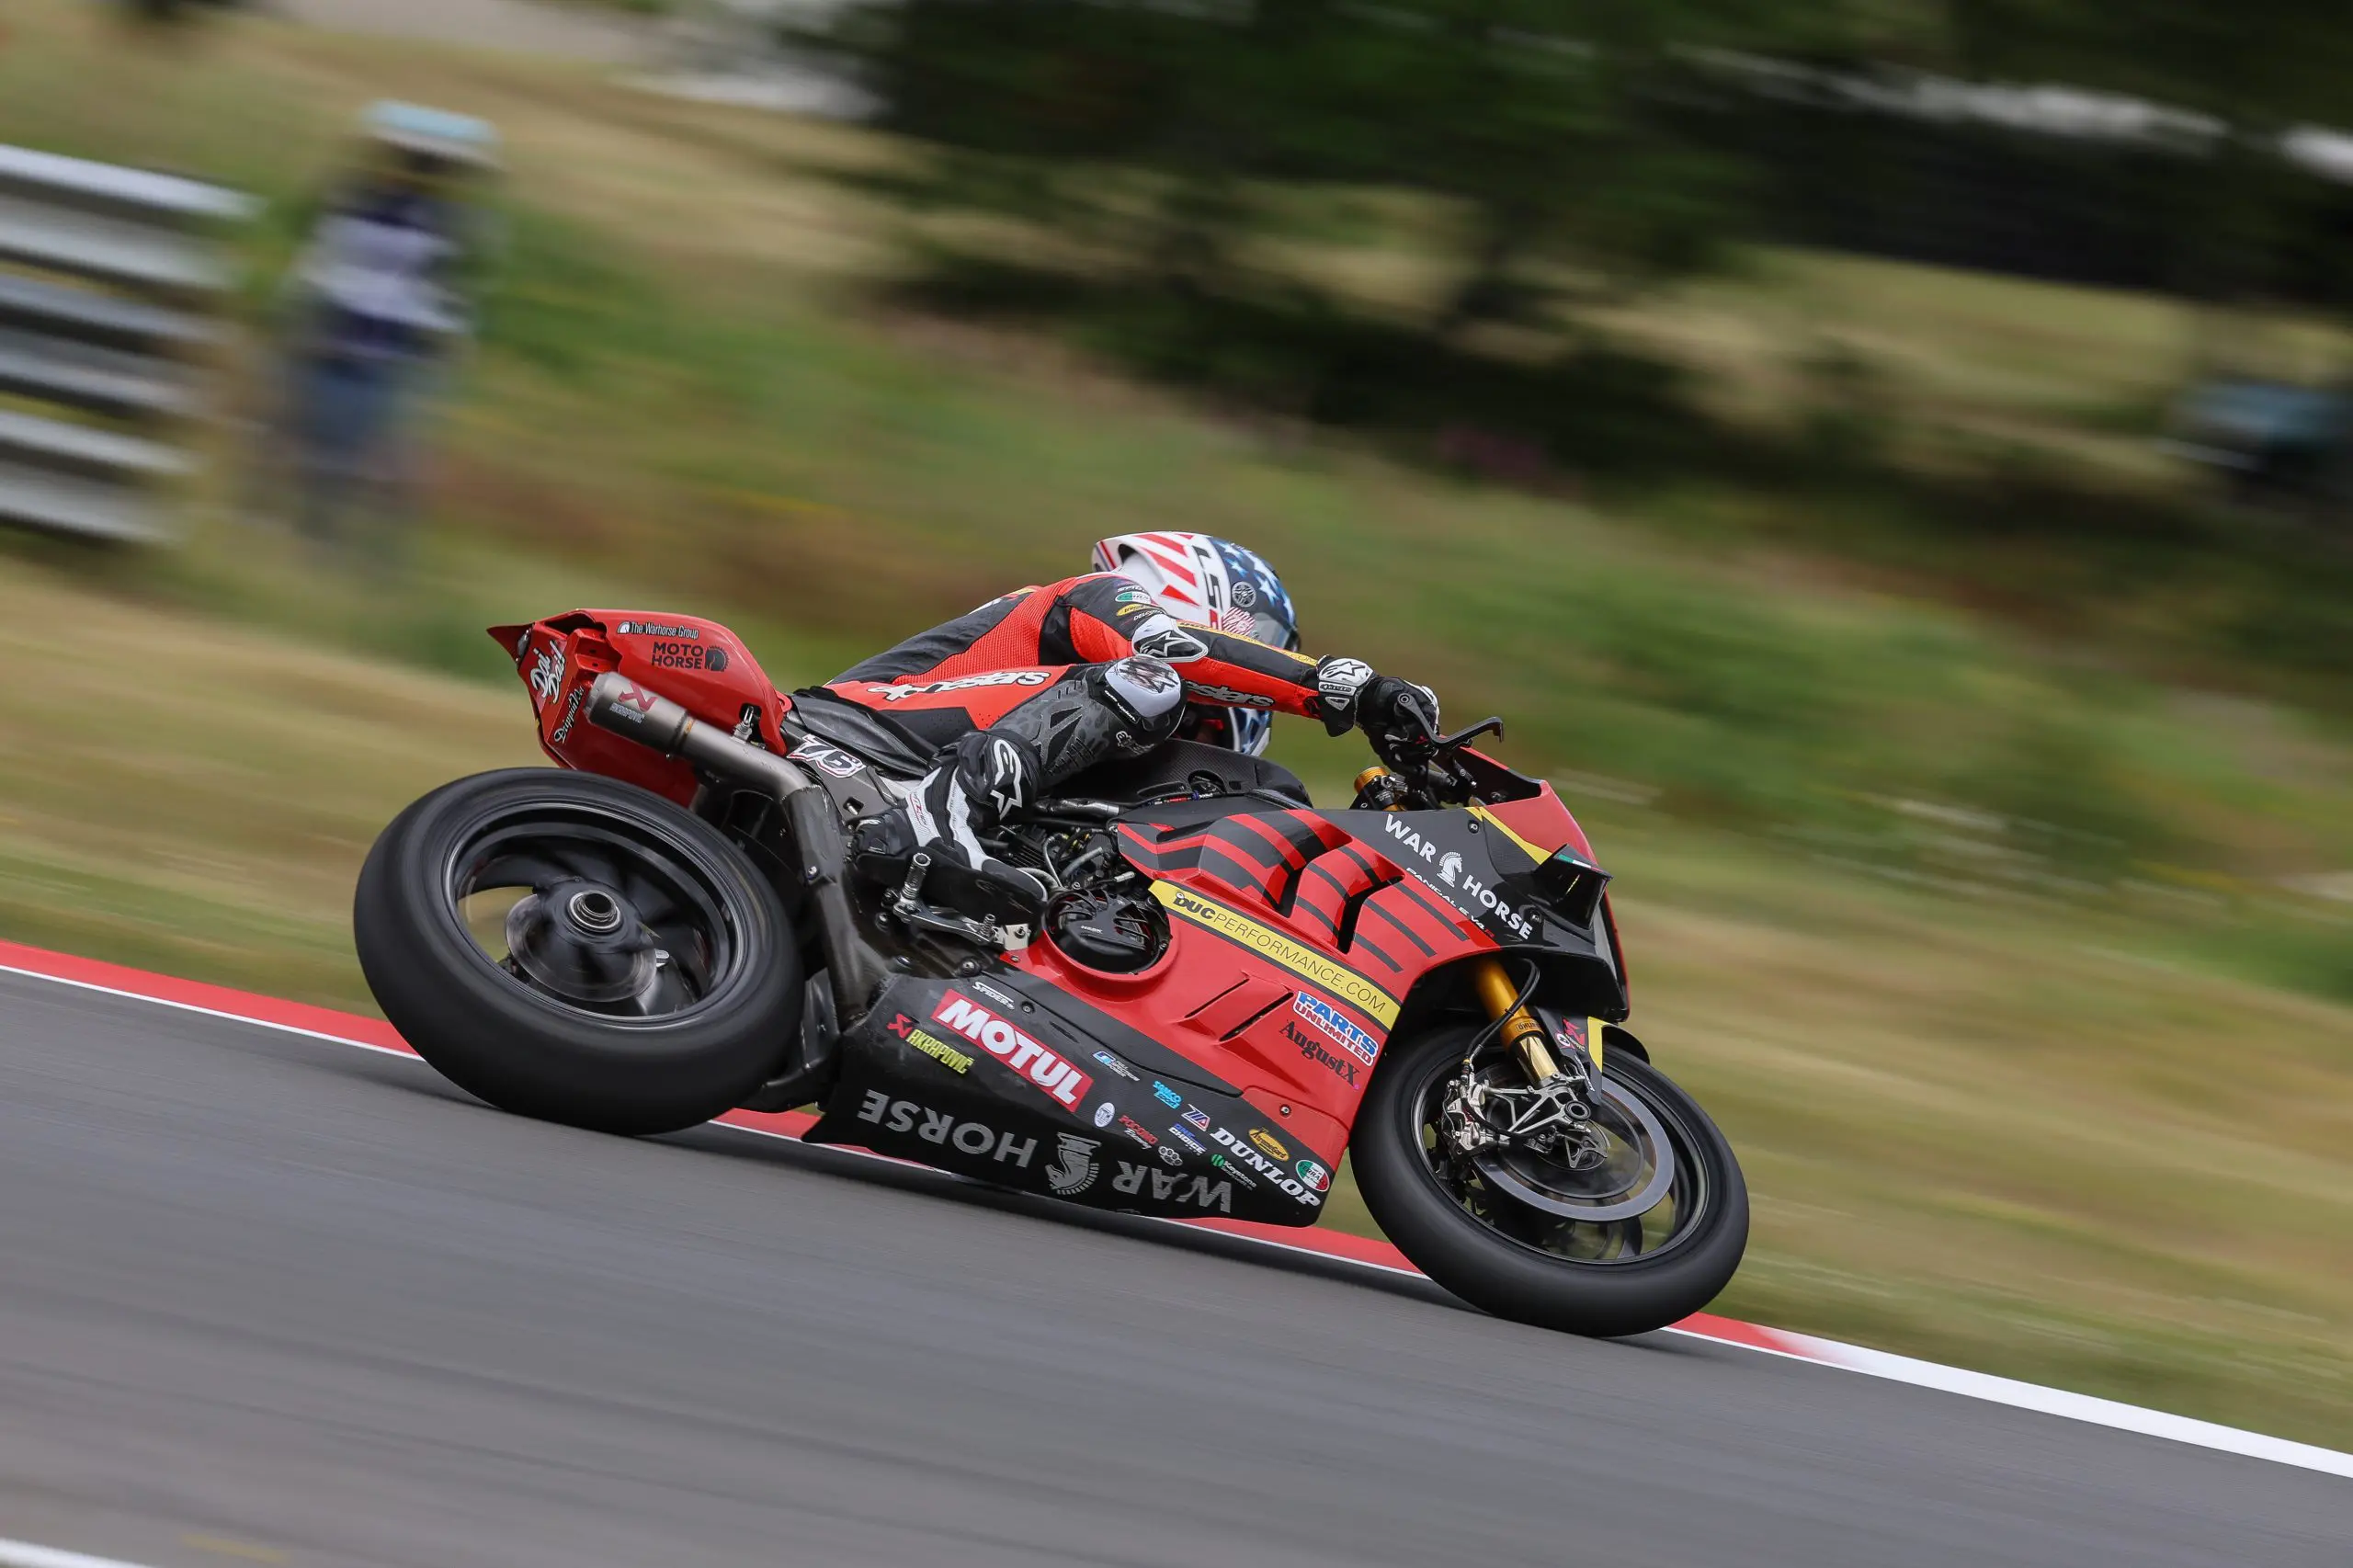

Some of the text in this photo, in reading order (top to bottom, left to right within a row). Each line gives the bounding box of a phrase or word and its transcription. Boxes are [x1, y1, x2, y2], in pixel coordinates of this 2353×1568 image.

[631, 621, 699, 640] The Warhorse Group
[652, 654, 702, 669] HORSE
[653, 642, 704, 656] MOTO
[787, 733, 866, 778] 76
[1384, 813, 1533, 940] WAR HORSE
[937, 999, 1083, 1105] MOTUL
[1295, 1002, 1372, 1064] UNLIMITED
[1298, 992, 1377, 1056] PARTS
[857, 1089, 1232, 1213] WAR HORSE
[1168, 1127, 1206, 1154] CHOICE
[1210, 1127, 1321, 1207] DUNLOP
